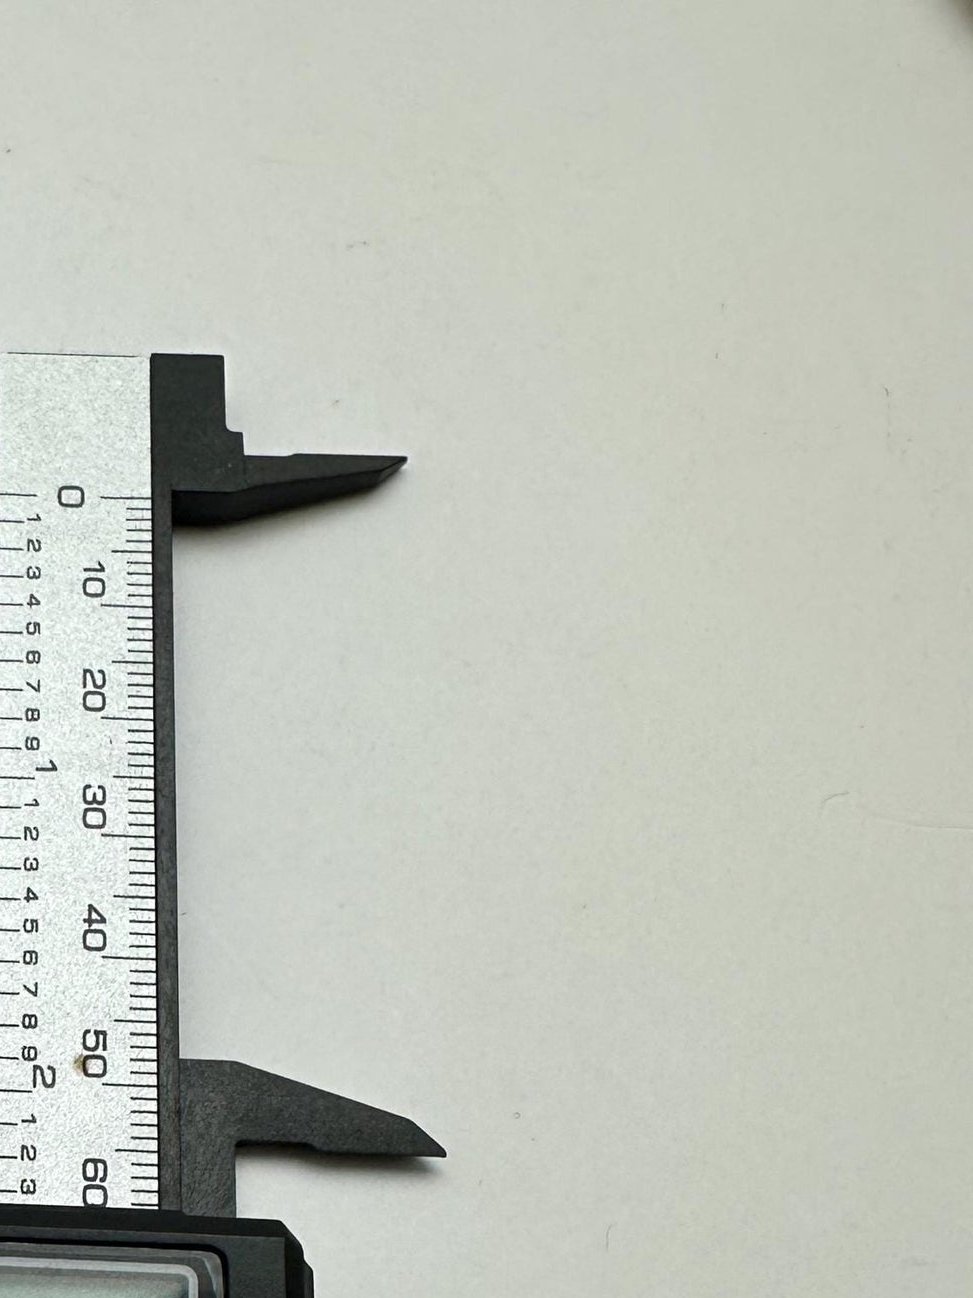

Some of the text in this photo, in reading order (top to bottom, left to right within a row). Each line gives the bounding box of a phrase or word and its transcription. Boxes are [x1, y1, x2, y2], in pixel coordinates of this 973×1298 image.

[57, 485, 85, 508] 0
[27, 539, 41, 552] 2
[26, 566, 41, 579] 3
[82, 561, 106, 598] 10
[27, 594, 40, 608] 4
[26, 622, 40, 635] 5
[26, 650, 41, 664] 6
[26, 680, 40, 692] 7
[83, 669, 106, 712] 20
[25, 708, 40, 722] 8
[25, 736, 40, 751] 9
[35, 760, 58, 772] 1
[24, 799, 39, 807] 1
[82, 784, 106, 829] 30
[24, 826, 39, 841] 2
[23, 857, 39, 872] 3
[24, 887, 38, 903] 4
[23, 919, 38, 933] 5
[82, 904, 107, 952] 40
[23, 950, 38, 965] 6
[23, 982, 38, 997] 7
[22, 1014, 38, 1029] 8
[22, 1046, 38, 1061] 9
[81, 1029, 108, 1078] 50
[33, 1065, 56, 1088] 2
[21, 1114, 37, 1123] 1
[21, 1145, 36, 1161] 2
[20, 1179, 36, 1195] 3
[82, 1158, 108, 1208] 60
